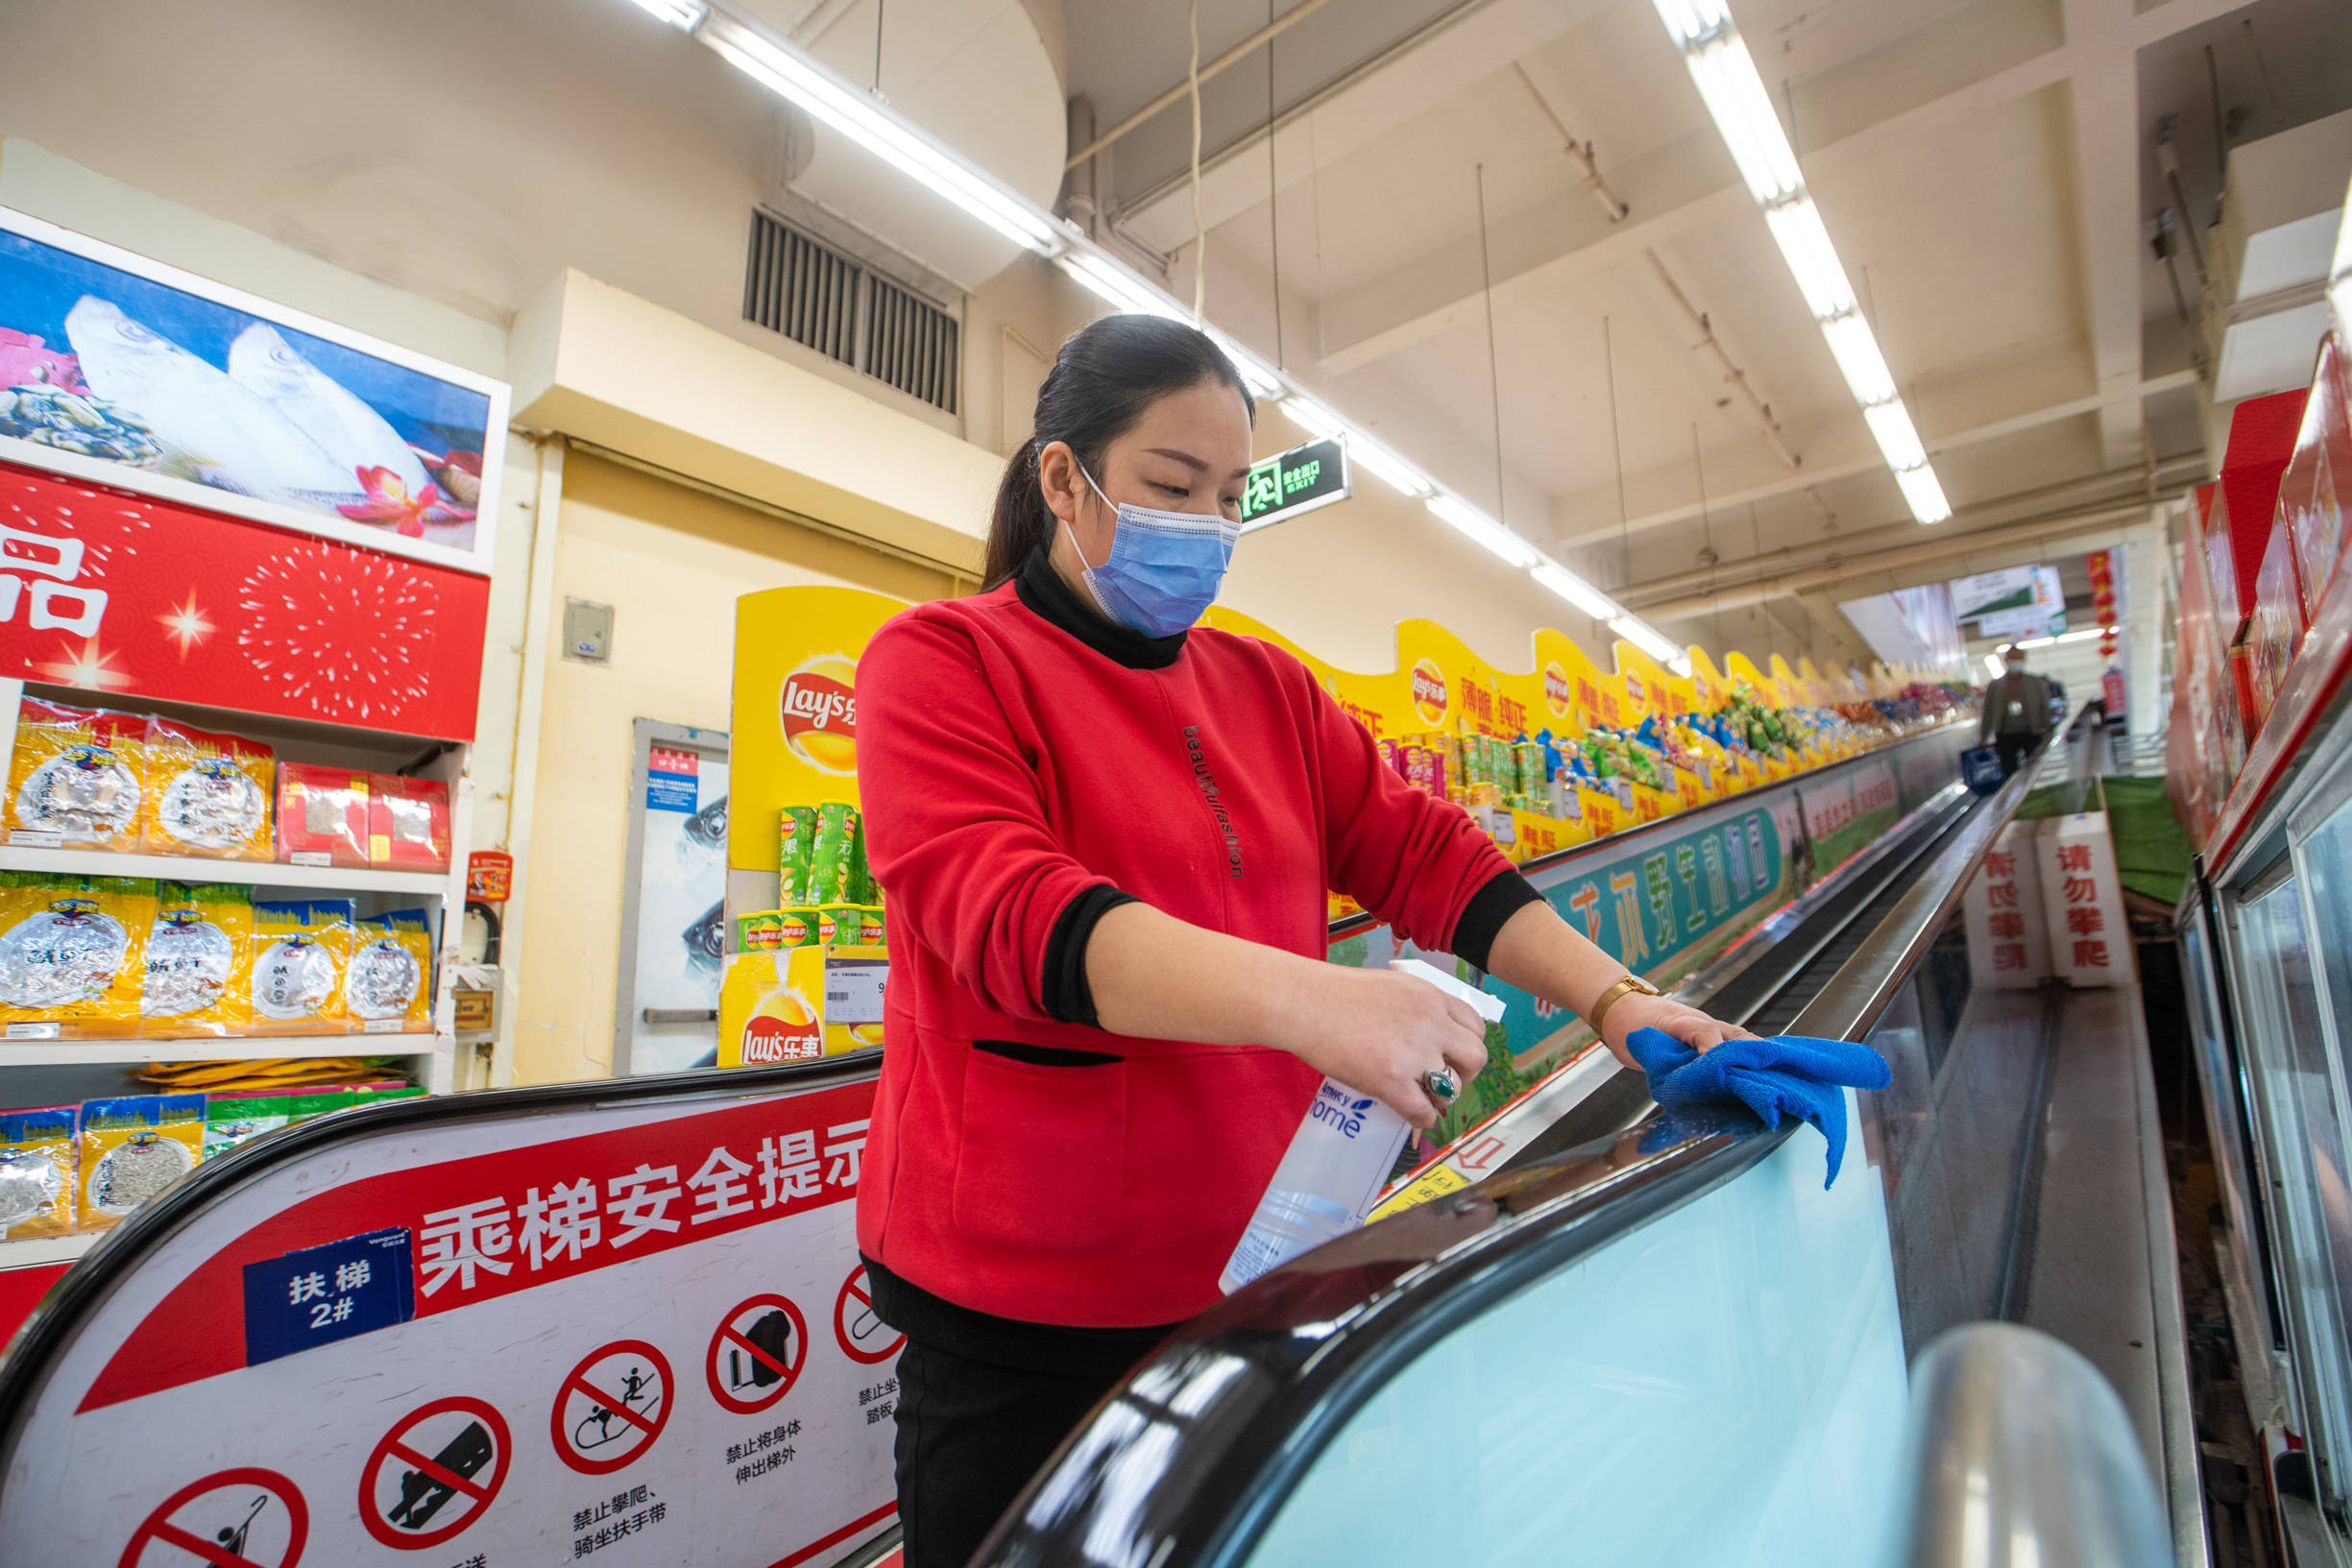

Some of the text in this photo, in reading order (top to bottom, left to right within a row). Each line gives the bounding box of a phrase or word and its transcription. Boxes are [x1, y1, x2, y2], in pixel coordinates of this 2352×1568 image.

[1283, 460, 1320, 485] 安全出口
[1287, 474, 1317, 494] EXIT
[0, 523, 109, 638] 品
[784, 681, 846, 729] Lay's
[2056, 844, 2110, 967] 请勿攀爬
[743, 1030, 820, 1065] Lay's 乐事
[420, 1119, 870, 1297] 乘梯安全提示
[289, 1259, 372, 1305] 扶梯
[309, 1296, 354, 1329] 2#
[859, 1377, 899, 1406] 禁止坐
[867, 1397, 900, 1425] 踏板
[726, 1418, 802, 1465] 禁止将身体
[736, 1445, 796, 1485] 伸出梯外
[574, 1502, 667, 1560] 骑坐扶手带
